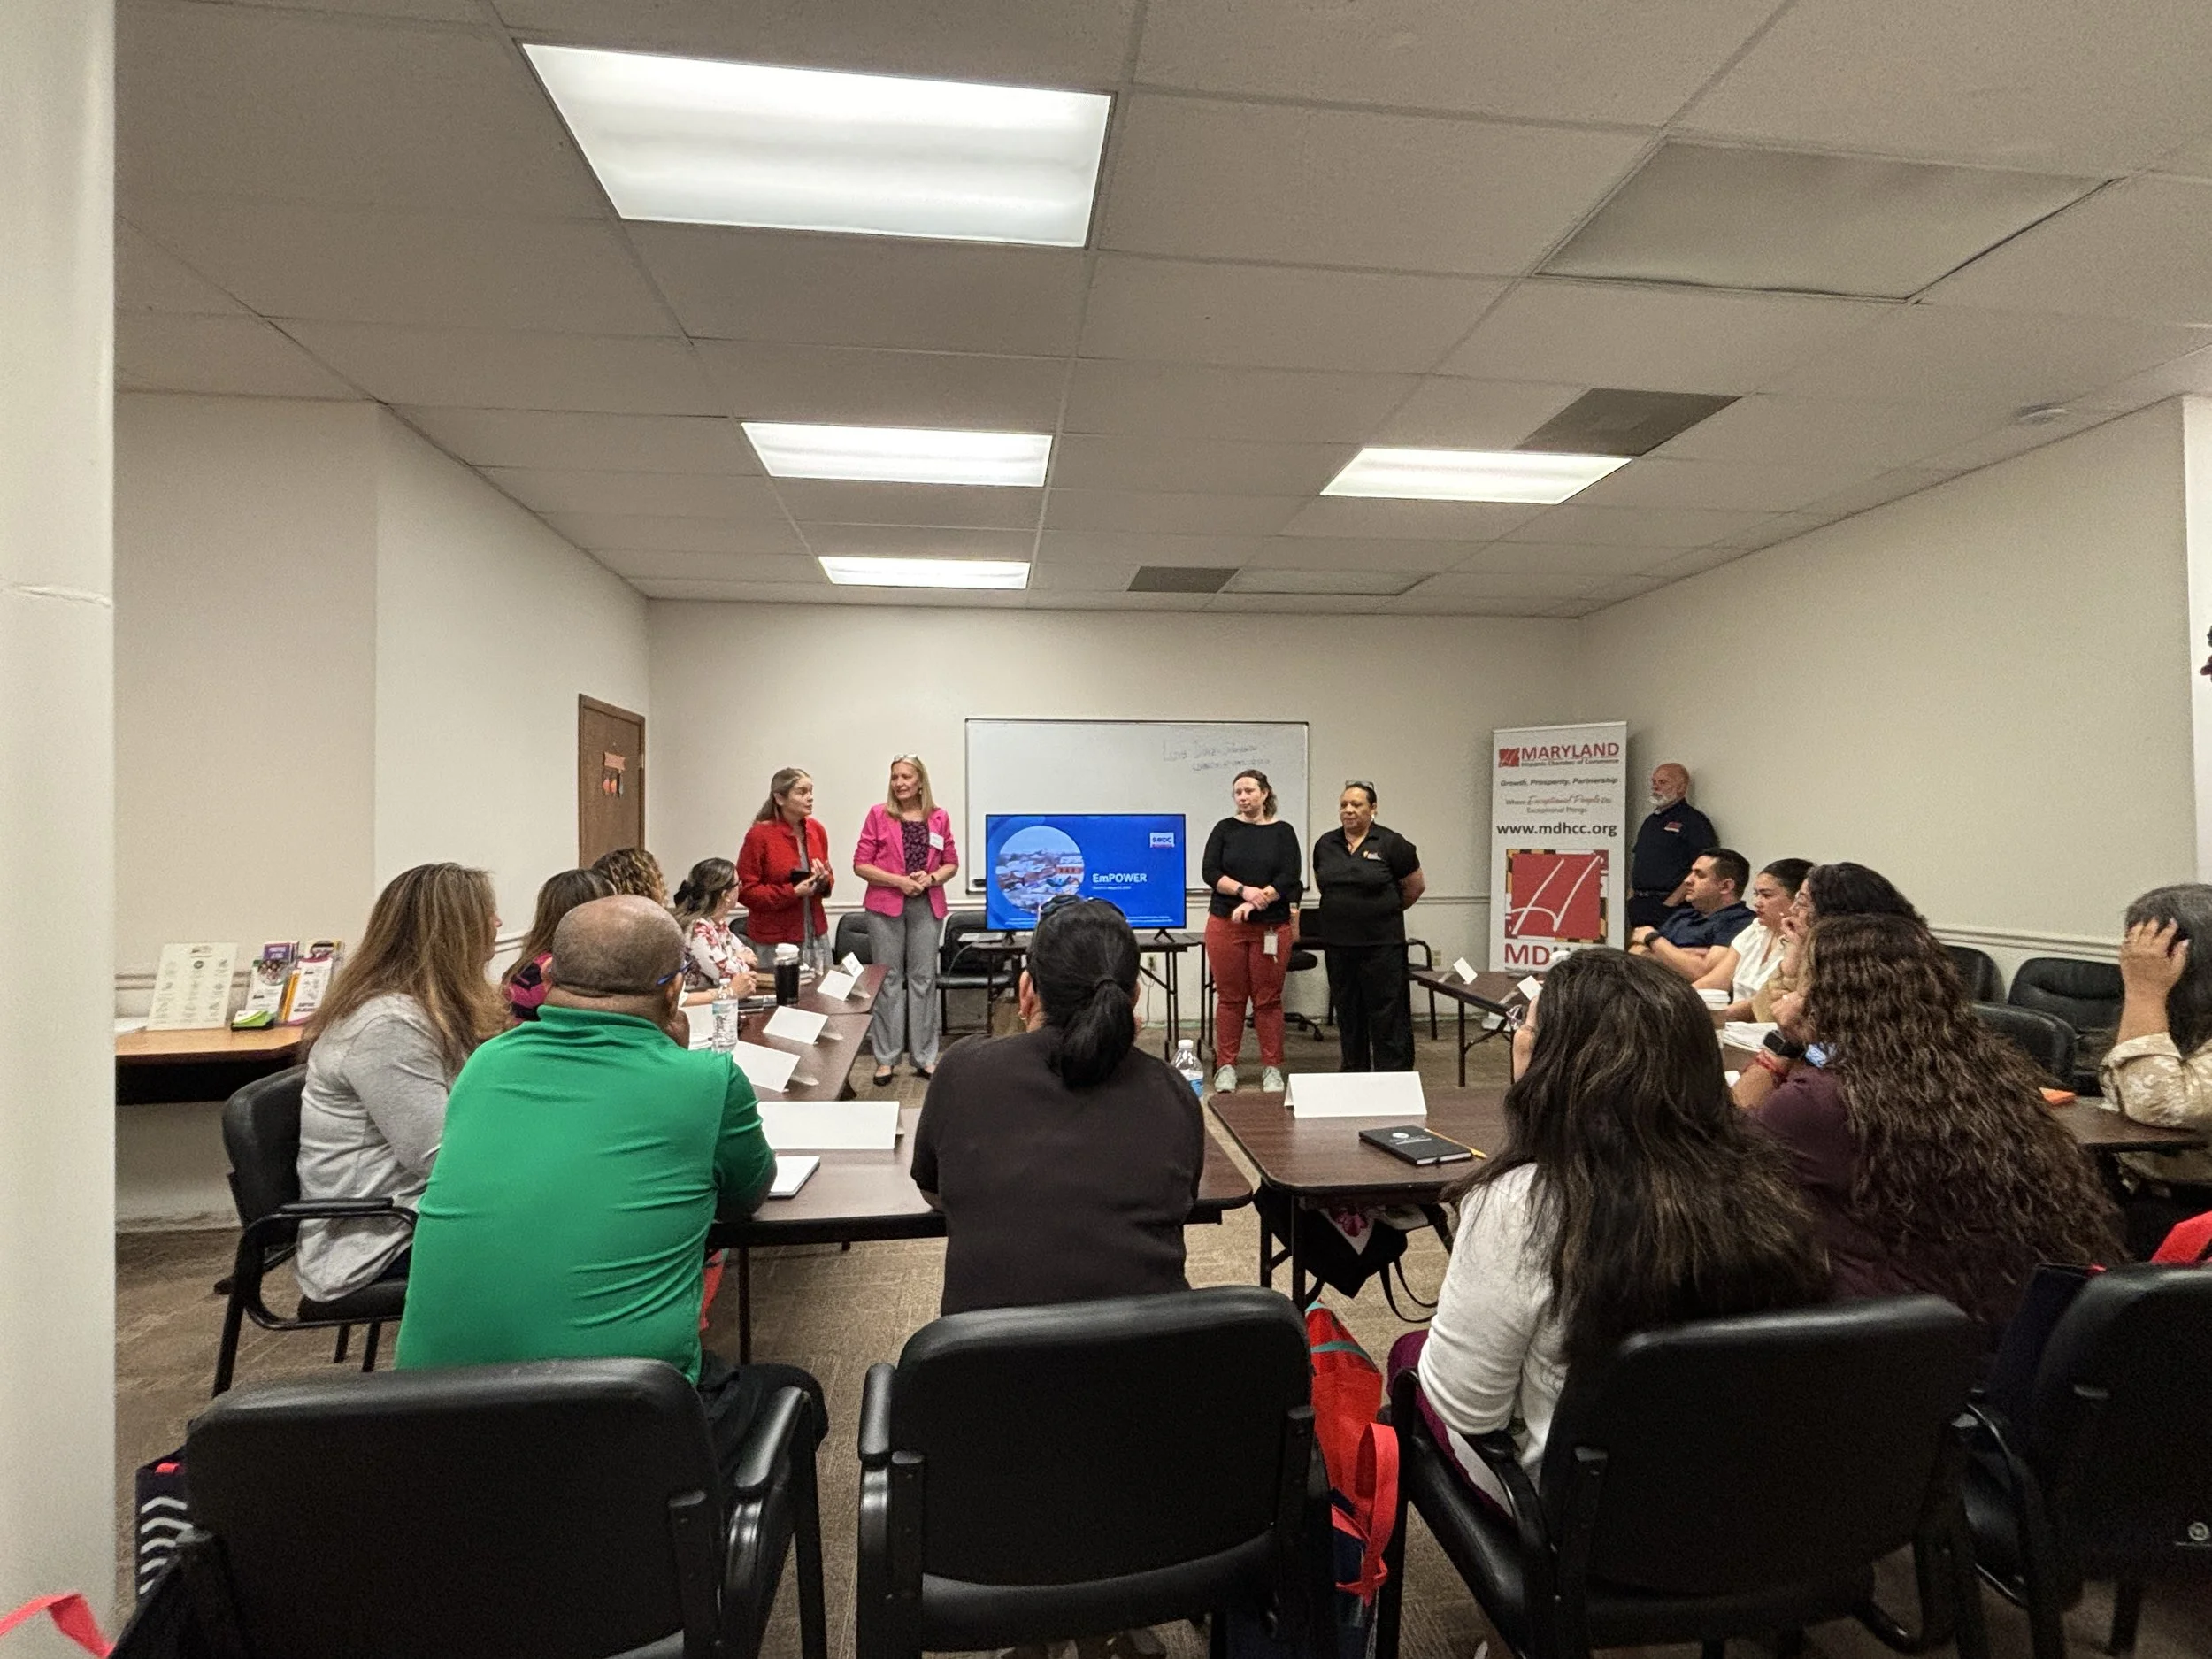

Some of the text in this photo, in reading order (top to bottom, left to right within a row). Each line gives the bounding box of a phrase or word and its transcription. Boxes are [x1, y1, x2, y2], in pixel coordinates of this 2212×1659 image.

[1522, 742, 1619, 760] MARYLAND
[1496, 821, 1617, 837] www.mdhcc.org
[1092, 872, 1148, 883] EmPOWER
